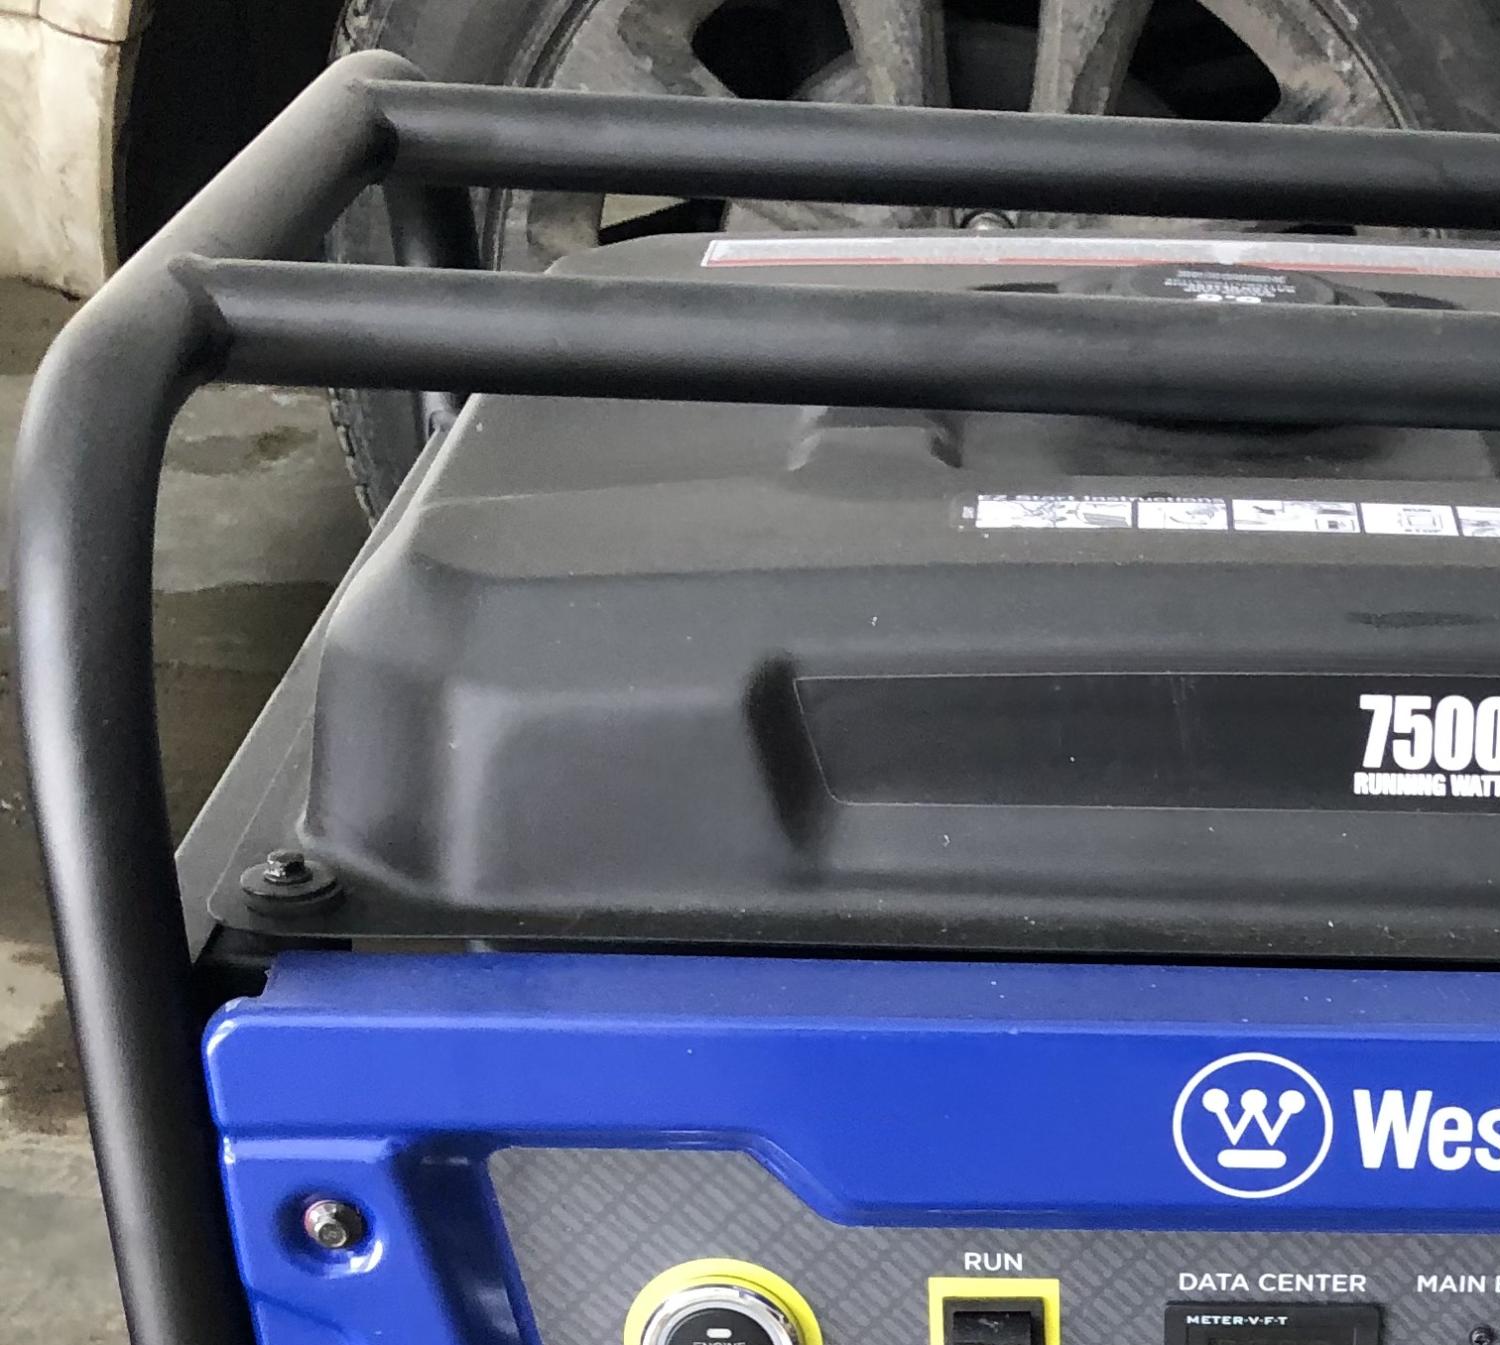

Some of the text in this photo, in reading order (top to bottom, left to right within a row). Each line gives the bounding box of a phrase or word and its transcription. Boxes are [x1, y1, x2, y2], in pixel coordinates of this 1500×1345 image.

[1353, 771, 1447, 797] RUNNING
[964, 1251, 1023, 1271] RUN
[1178, 1272, 1367, 1293] DATA CENTER
[1417, 1274, 1486, 1293] MAIN
